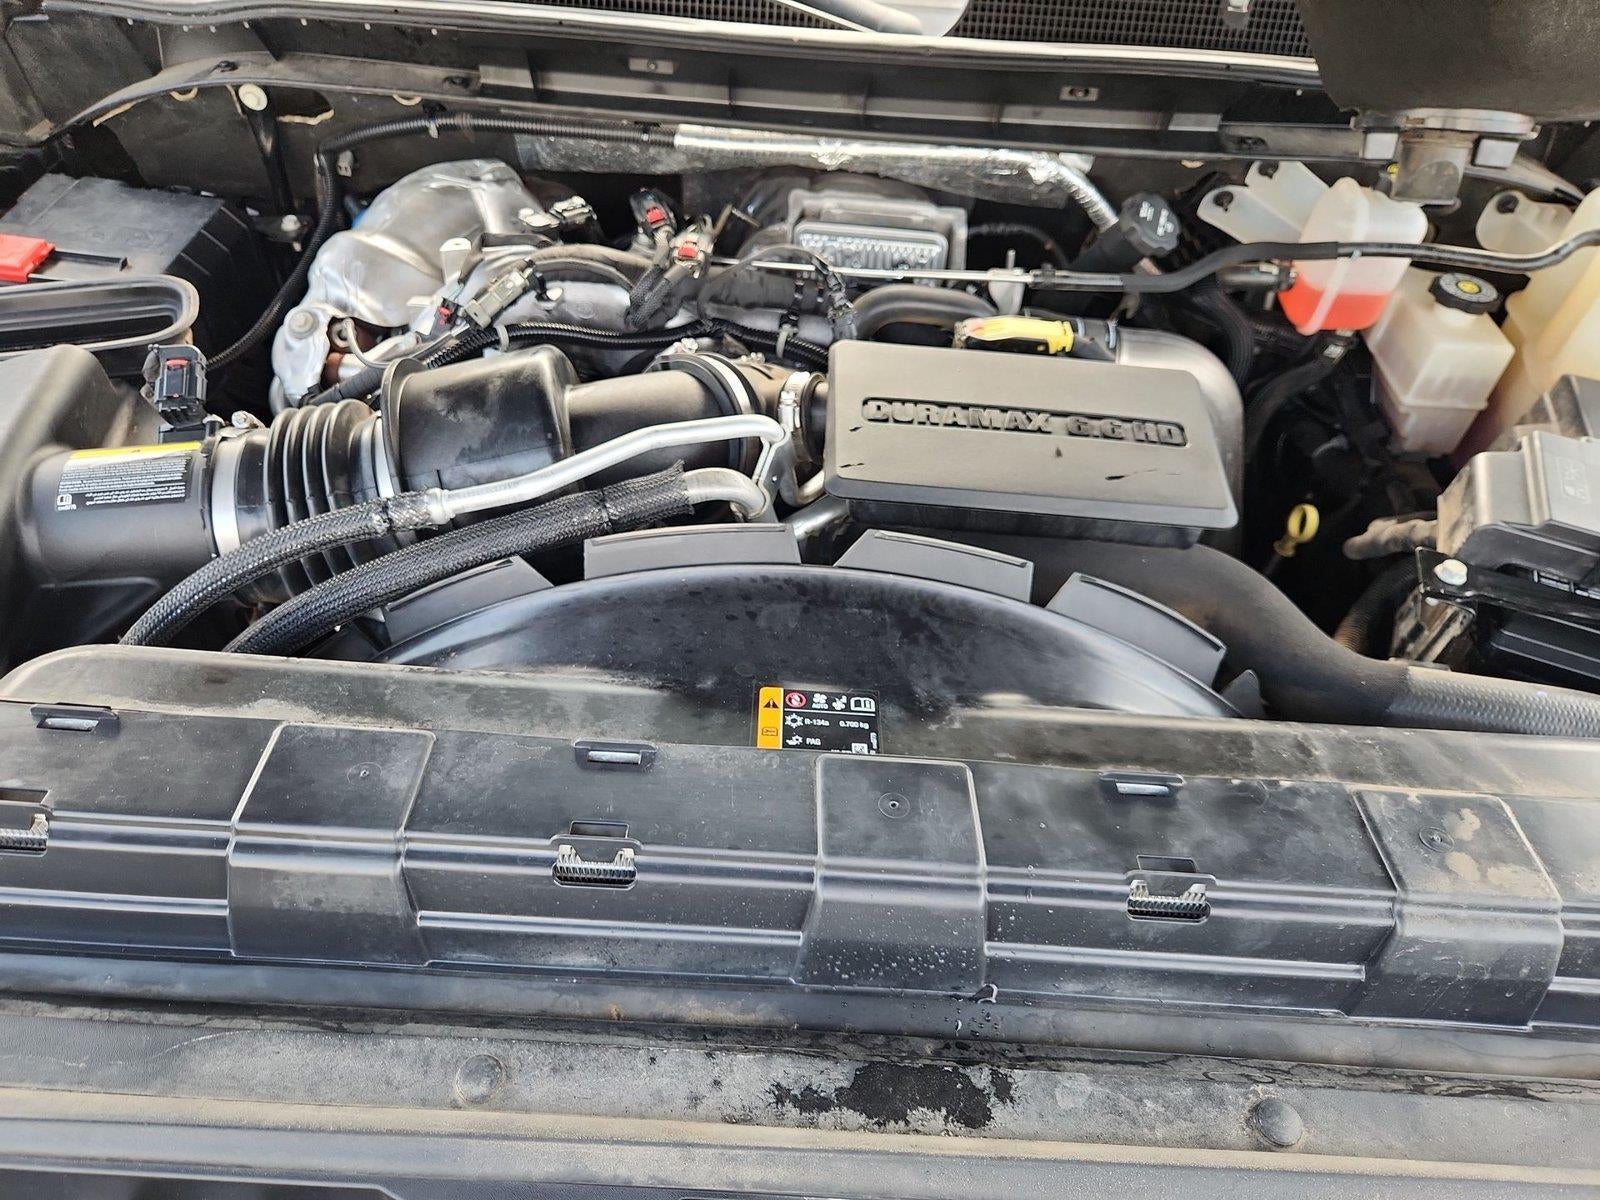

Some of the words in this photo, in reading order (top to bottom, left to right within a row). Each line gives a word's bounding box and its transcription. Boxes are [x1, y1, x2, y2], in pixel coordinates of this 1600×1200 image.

[864, 399, 1052, 433] DURAMAX
[1067, 414, 1124, 439] 6.6
[1131, 419, 1187, 446] HD
[804, 718, 830, 726] R-134a
[860, 721, 869, 730] kg
[806, 737, 821, 745] PAG
